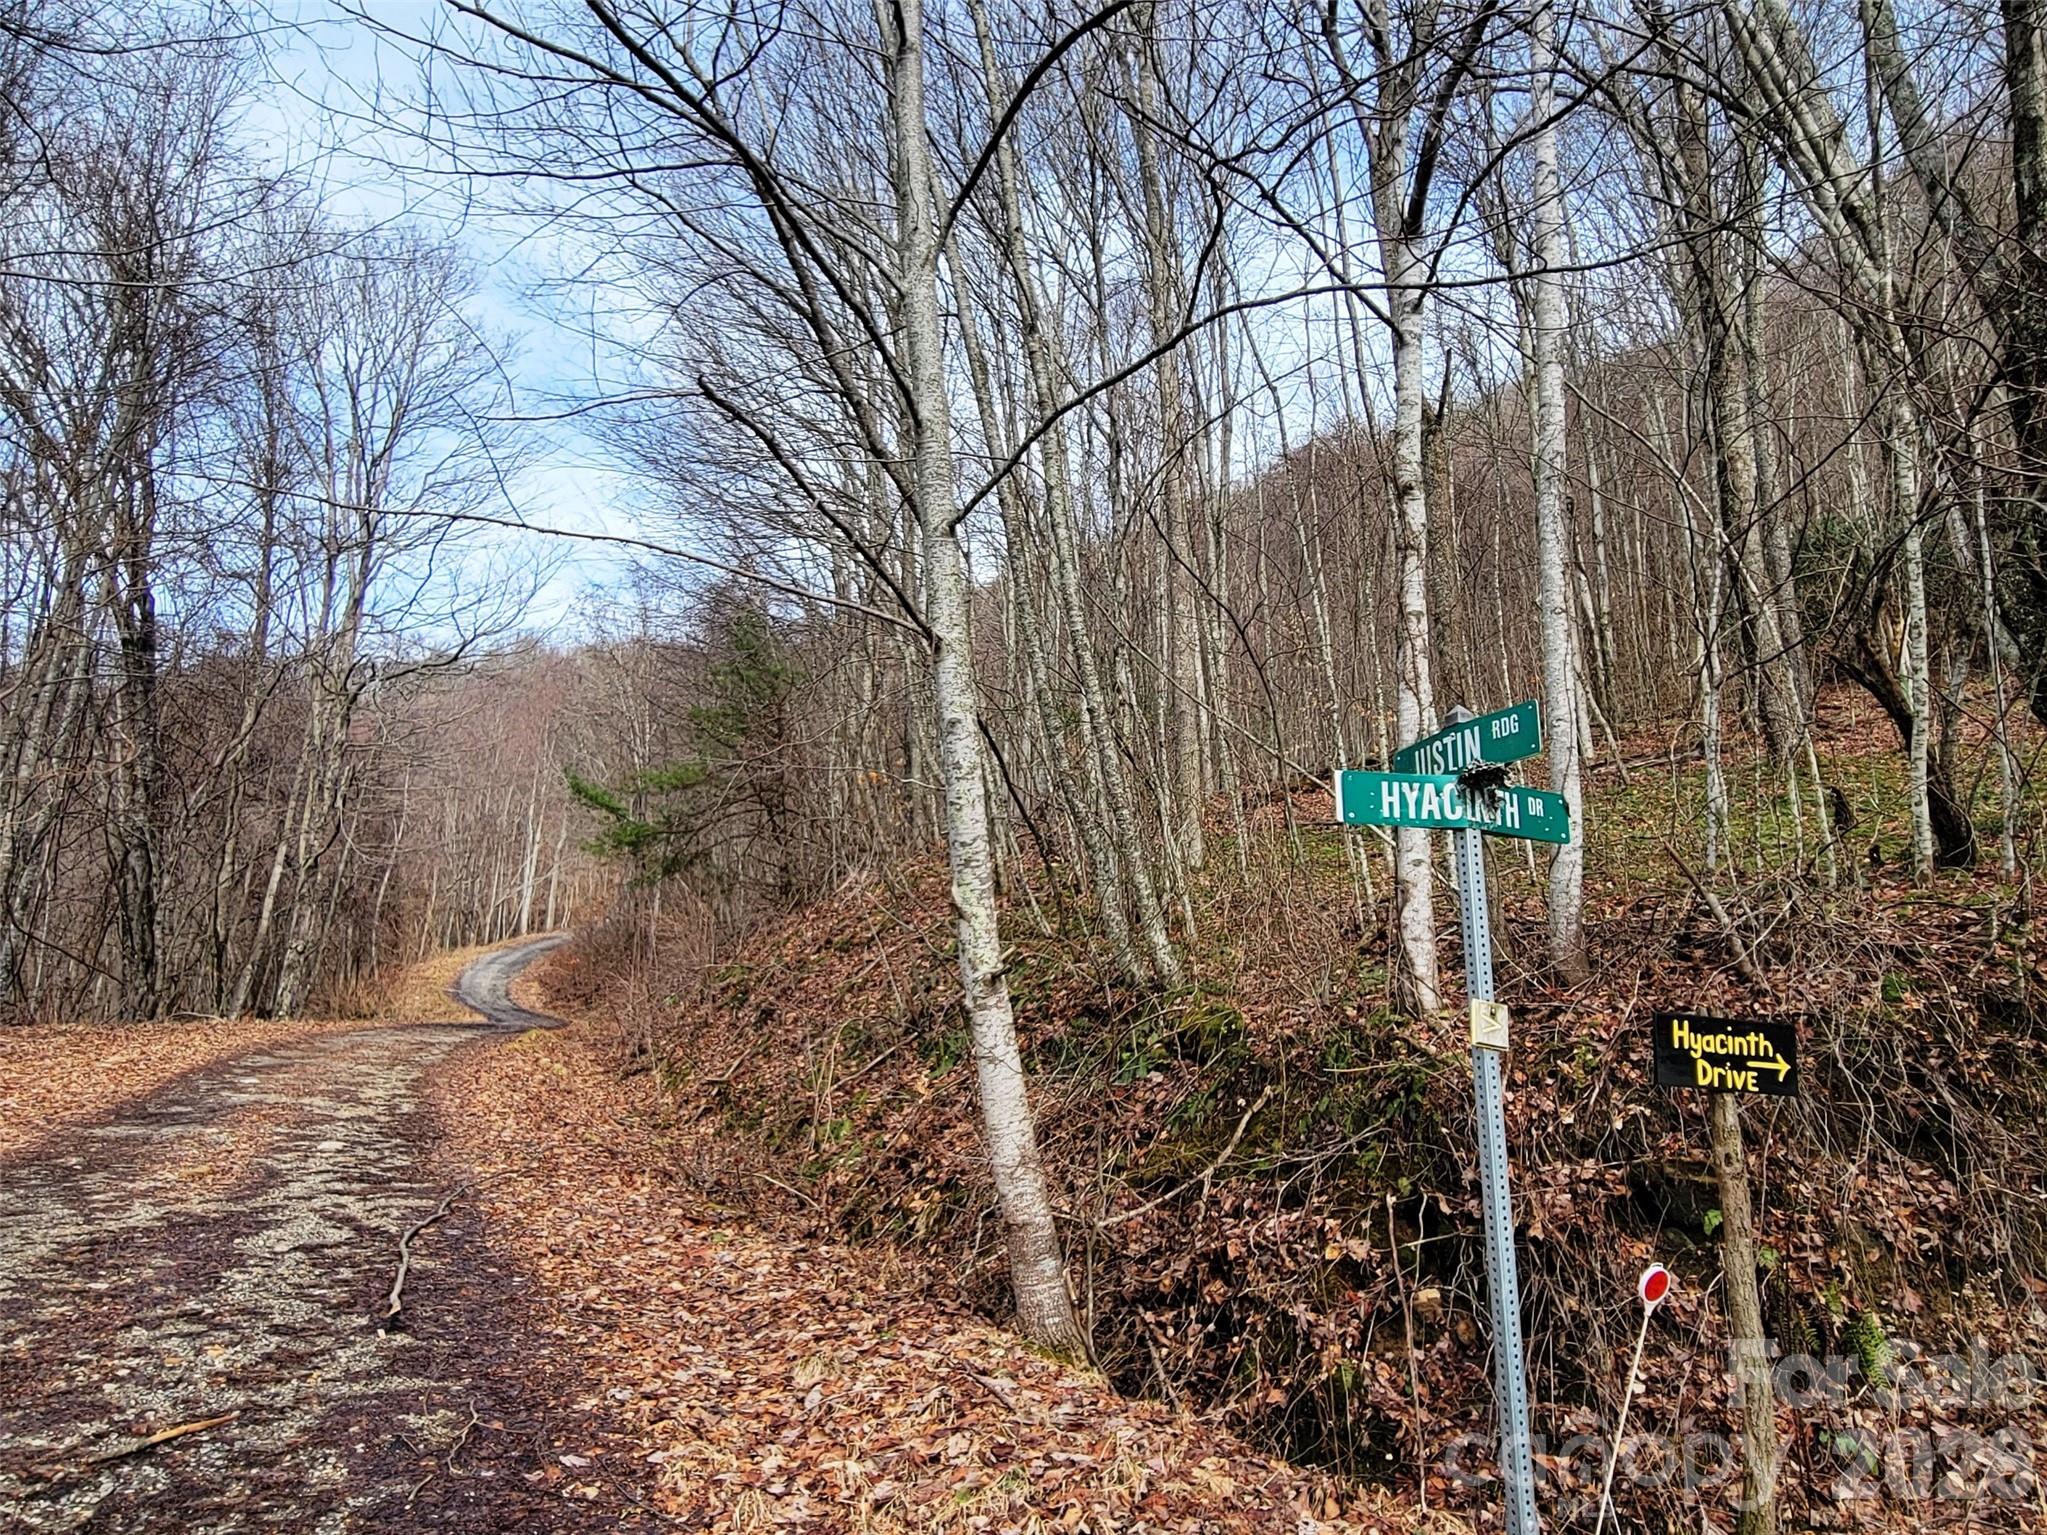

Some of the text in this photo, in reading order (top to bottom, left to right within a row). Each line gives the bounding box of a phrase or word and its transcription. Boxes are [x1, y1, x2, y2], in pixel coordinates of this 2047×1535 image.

[1491, 713, 1520, 740] RDG
[1528, 796, 1544, 817] DR
[1673, 1019, 1773, 1058] Hyacinth
